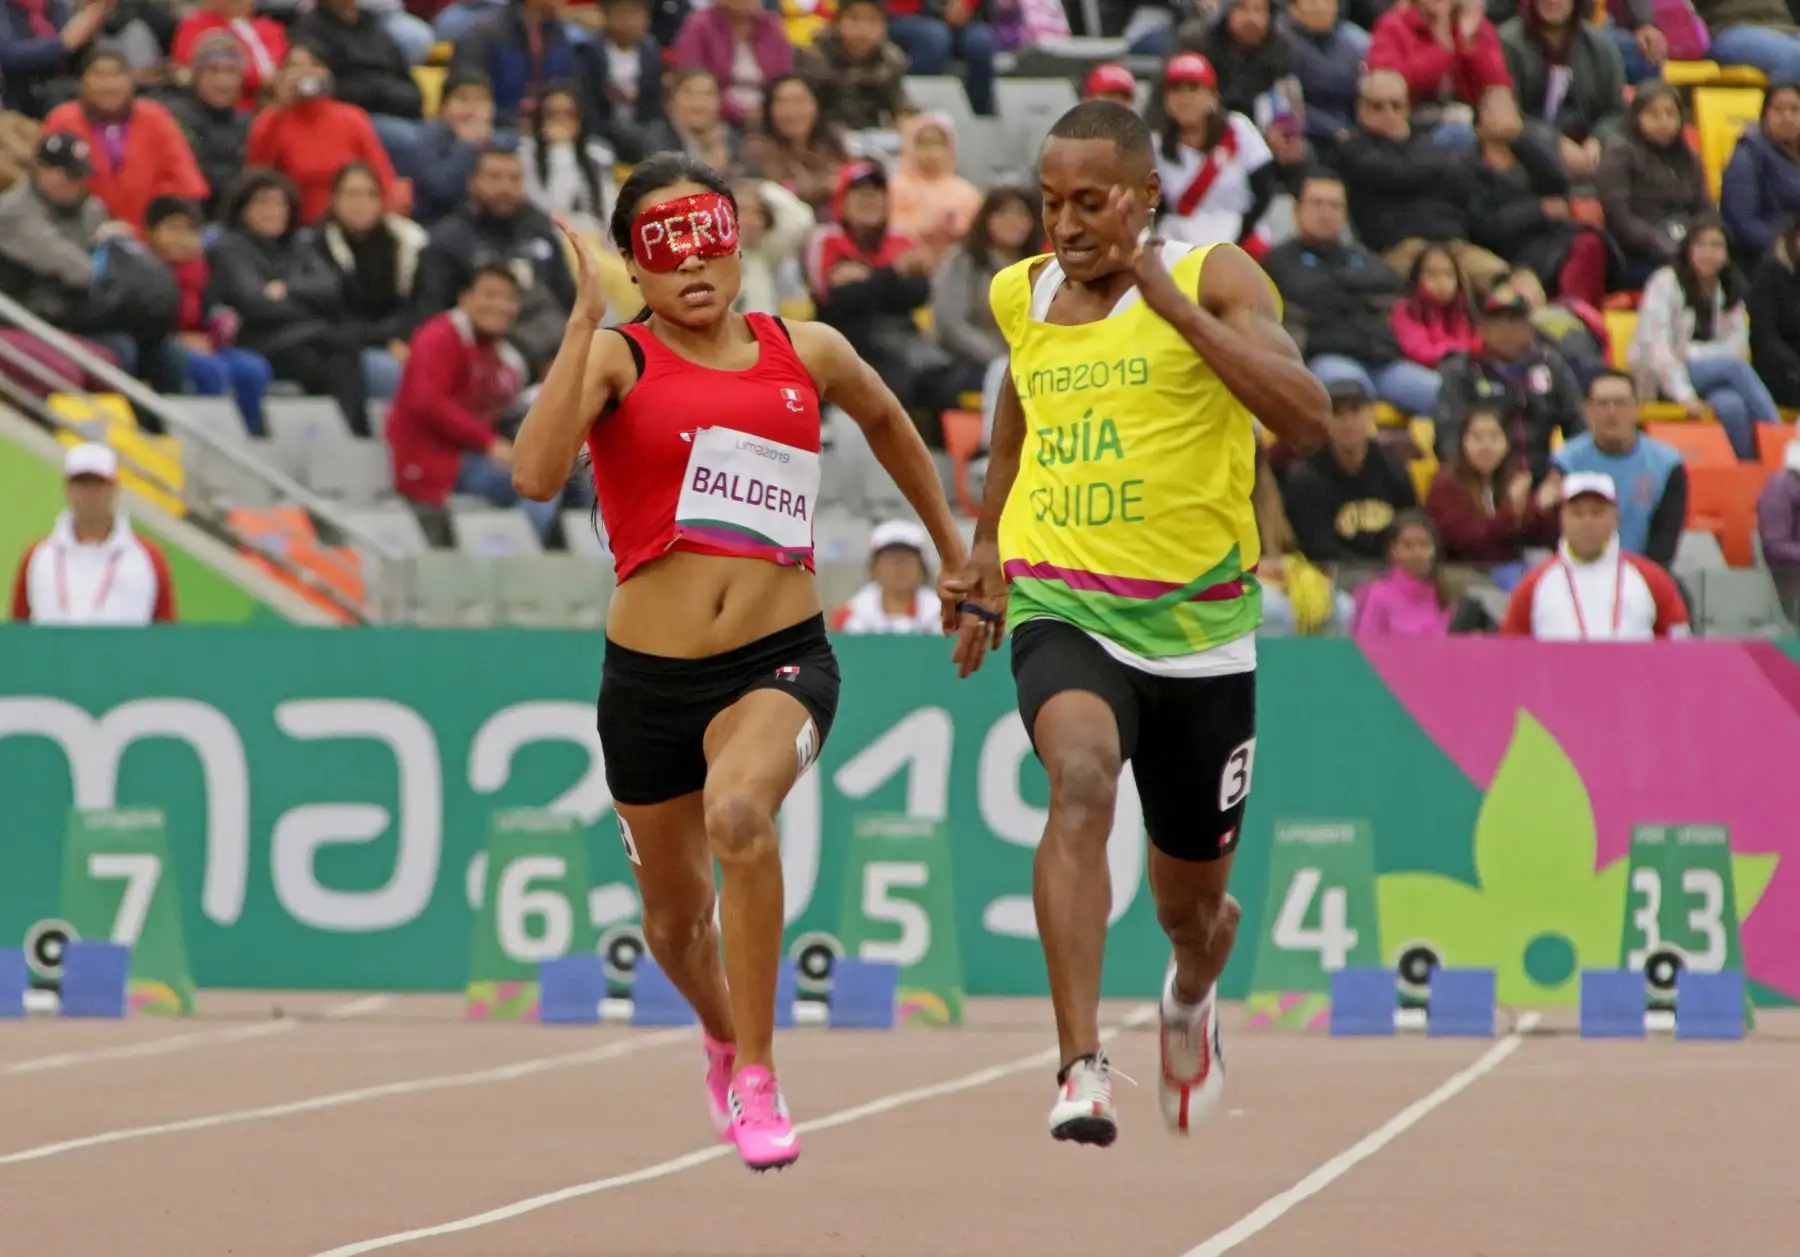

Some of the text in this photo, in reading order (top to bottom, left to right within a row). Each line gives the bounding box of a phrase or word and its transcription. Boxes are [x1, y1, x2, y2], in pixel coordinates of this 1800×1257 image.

[641, 198, 731, 260] PERÚ
[1015, 358, 1148, 400] Lima2019
[1037, 408, 1124, 467] GUÍA
[692, 466, 807, 521] BALDERA
[1029, 479, 1145, 527] GUIDE
[1227, 747, 1249, 806] 3
[88, 853, 162, 945] 7
[497, 855, 573, 961] 6
[859, 861, 932, 966] 5
[1272, 868, 1358, 971] 4
